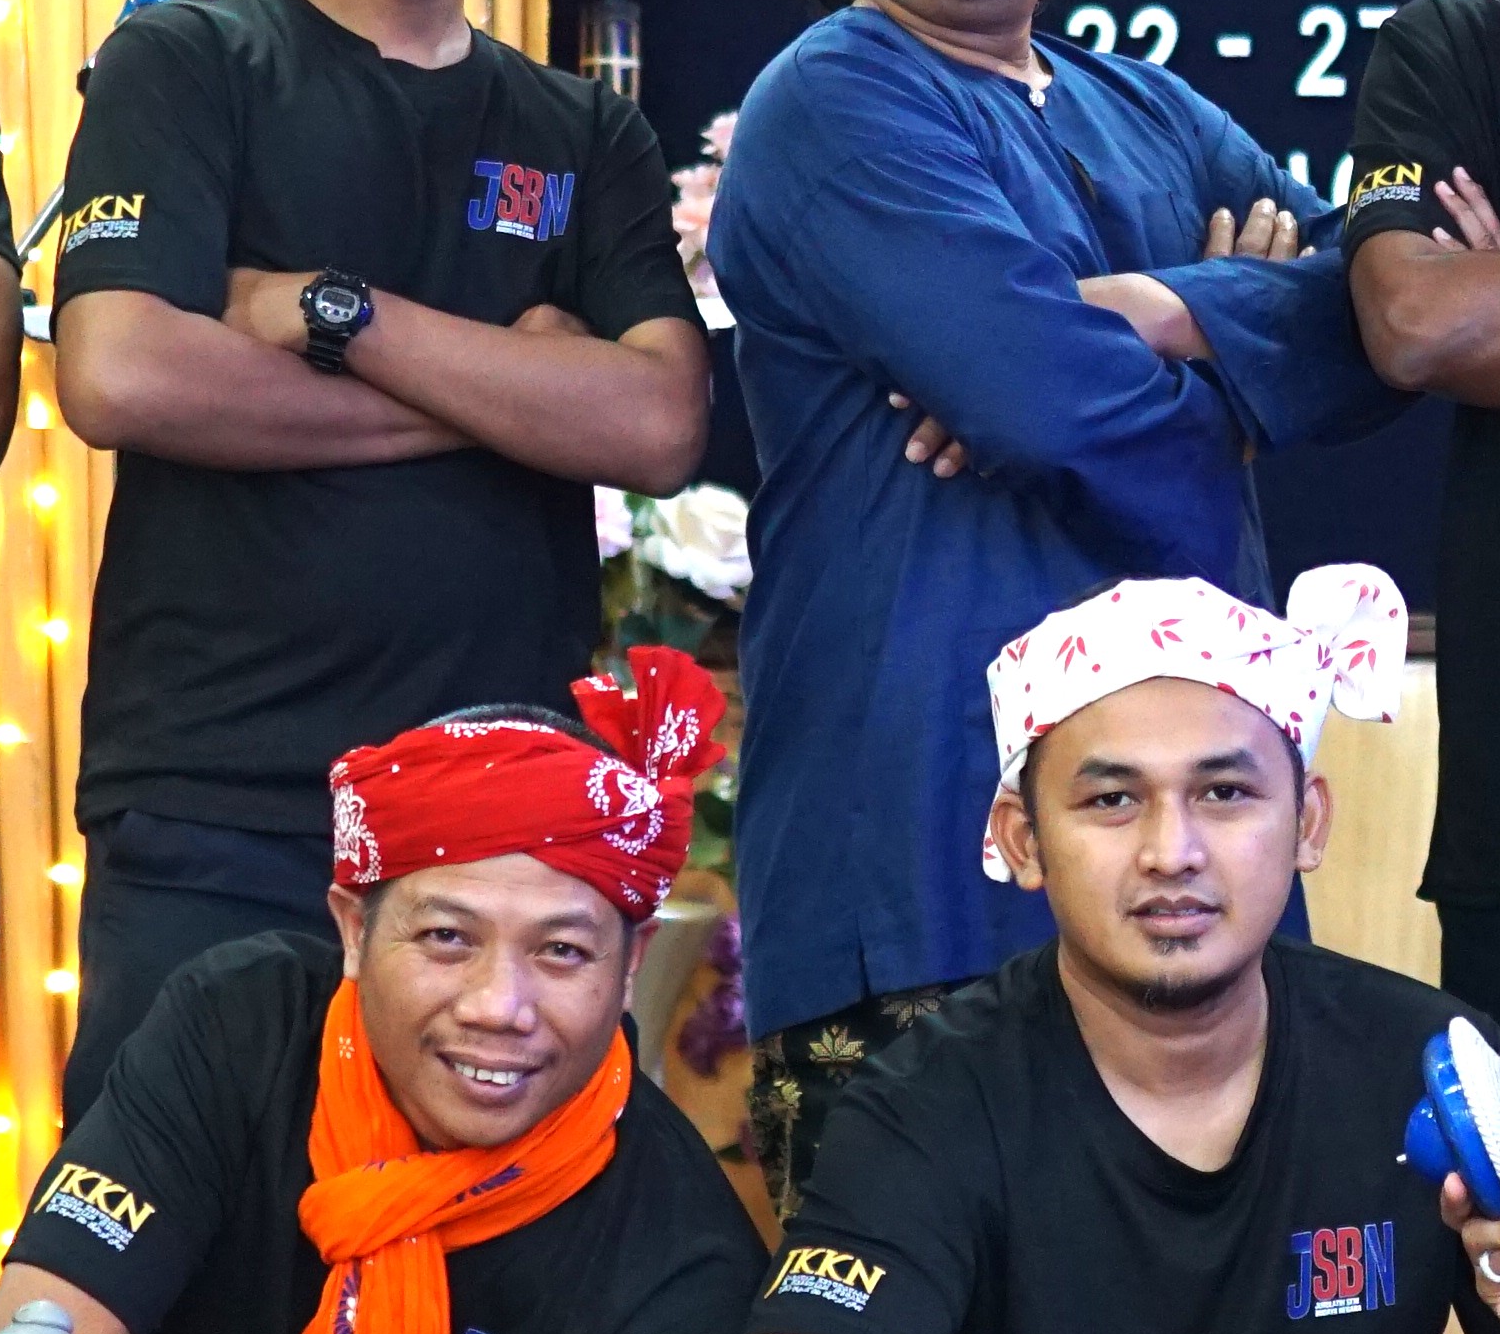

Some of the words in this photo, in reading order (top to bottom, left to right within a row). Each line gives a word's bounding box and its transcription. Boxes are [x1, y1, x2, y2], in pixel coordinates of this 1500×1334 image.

[467, 160, 576, 242] JSBN
[33, 1163, 156, 1233] JKKN
[763, 1247, 887, 1300] JKKN
[1286, 1221, 1396, 1320] JSBN
